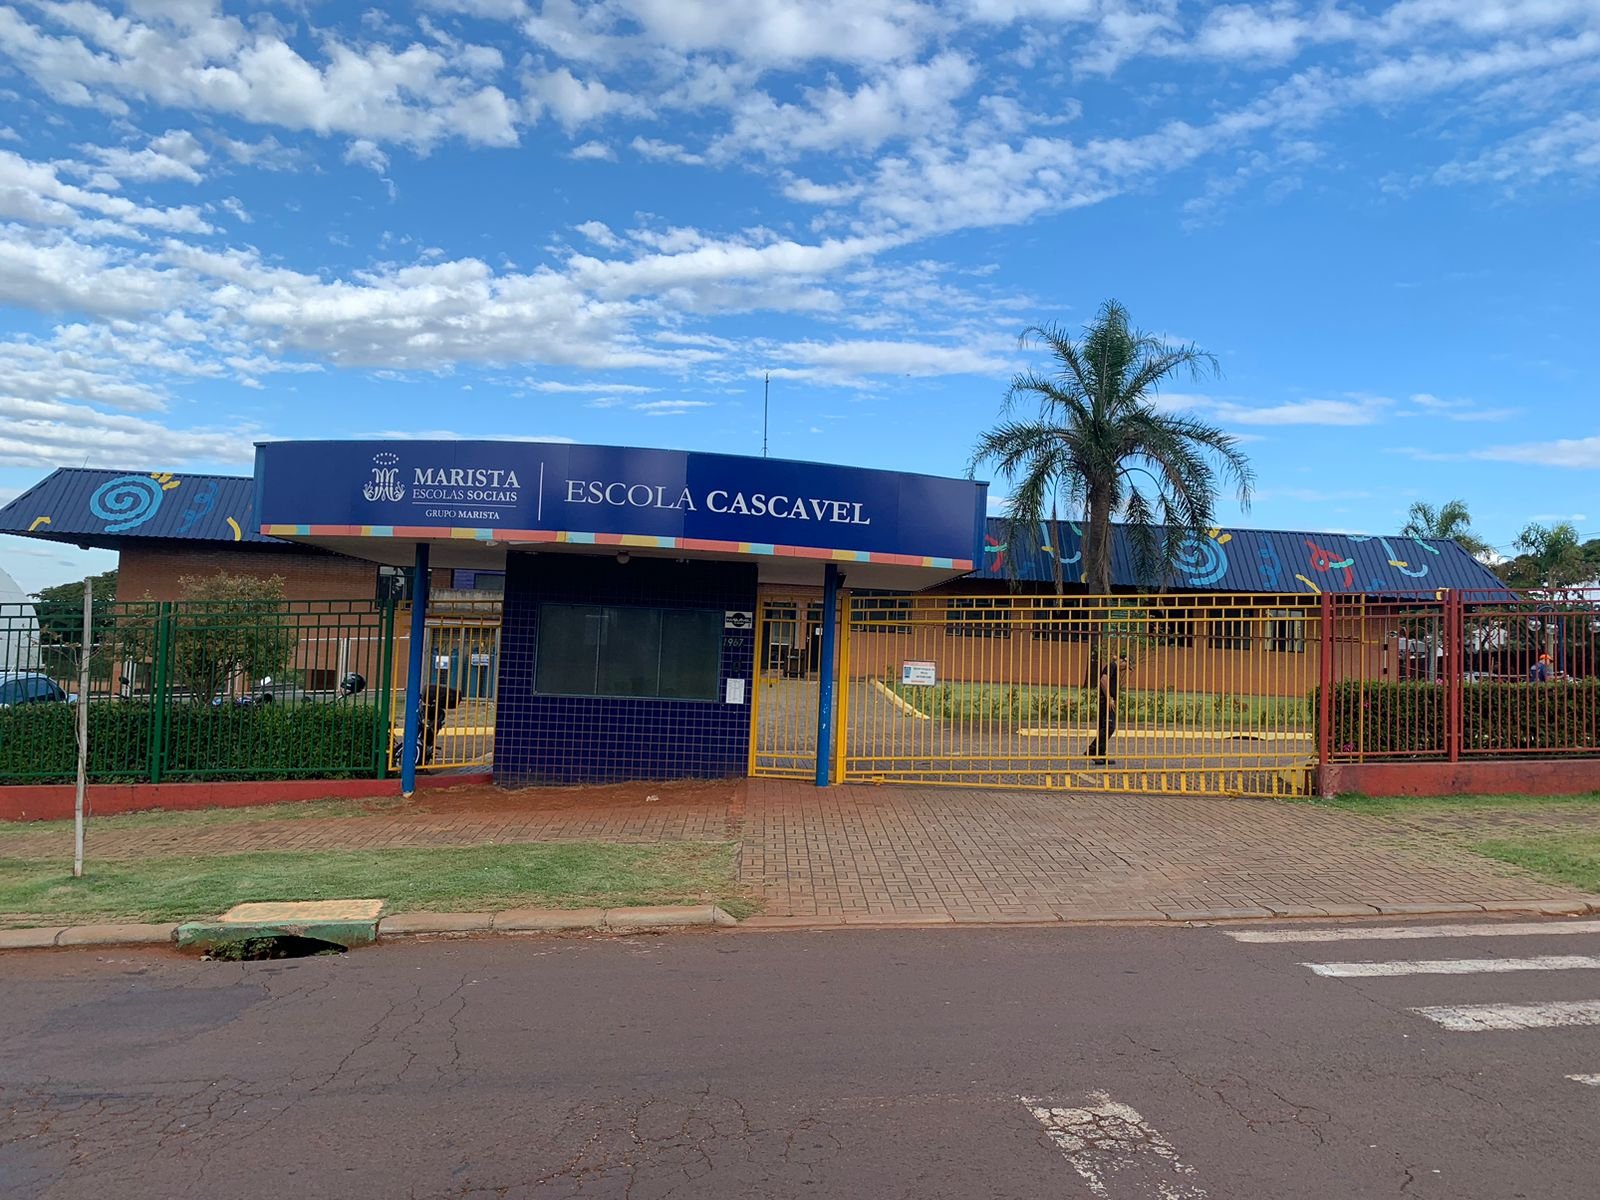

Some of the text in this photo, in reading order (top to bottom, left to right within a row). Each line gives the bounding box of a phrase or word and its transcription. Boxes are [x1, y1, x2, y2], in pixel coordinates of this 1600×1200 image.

[413, 468, 520, 488] MARISTA
[412, 488, 518, 502] ESCOLAS SOCIAIS
[564, 479, 871, 525] ESCOLA CASCAVEL
[425, 509, 500, 520] GRUPO MARISTA
